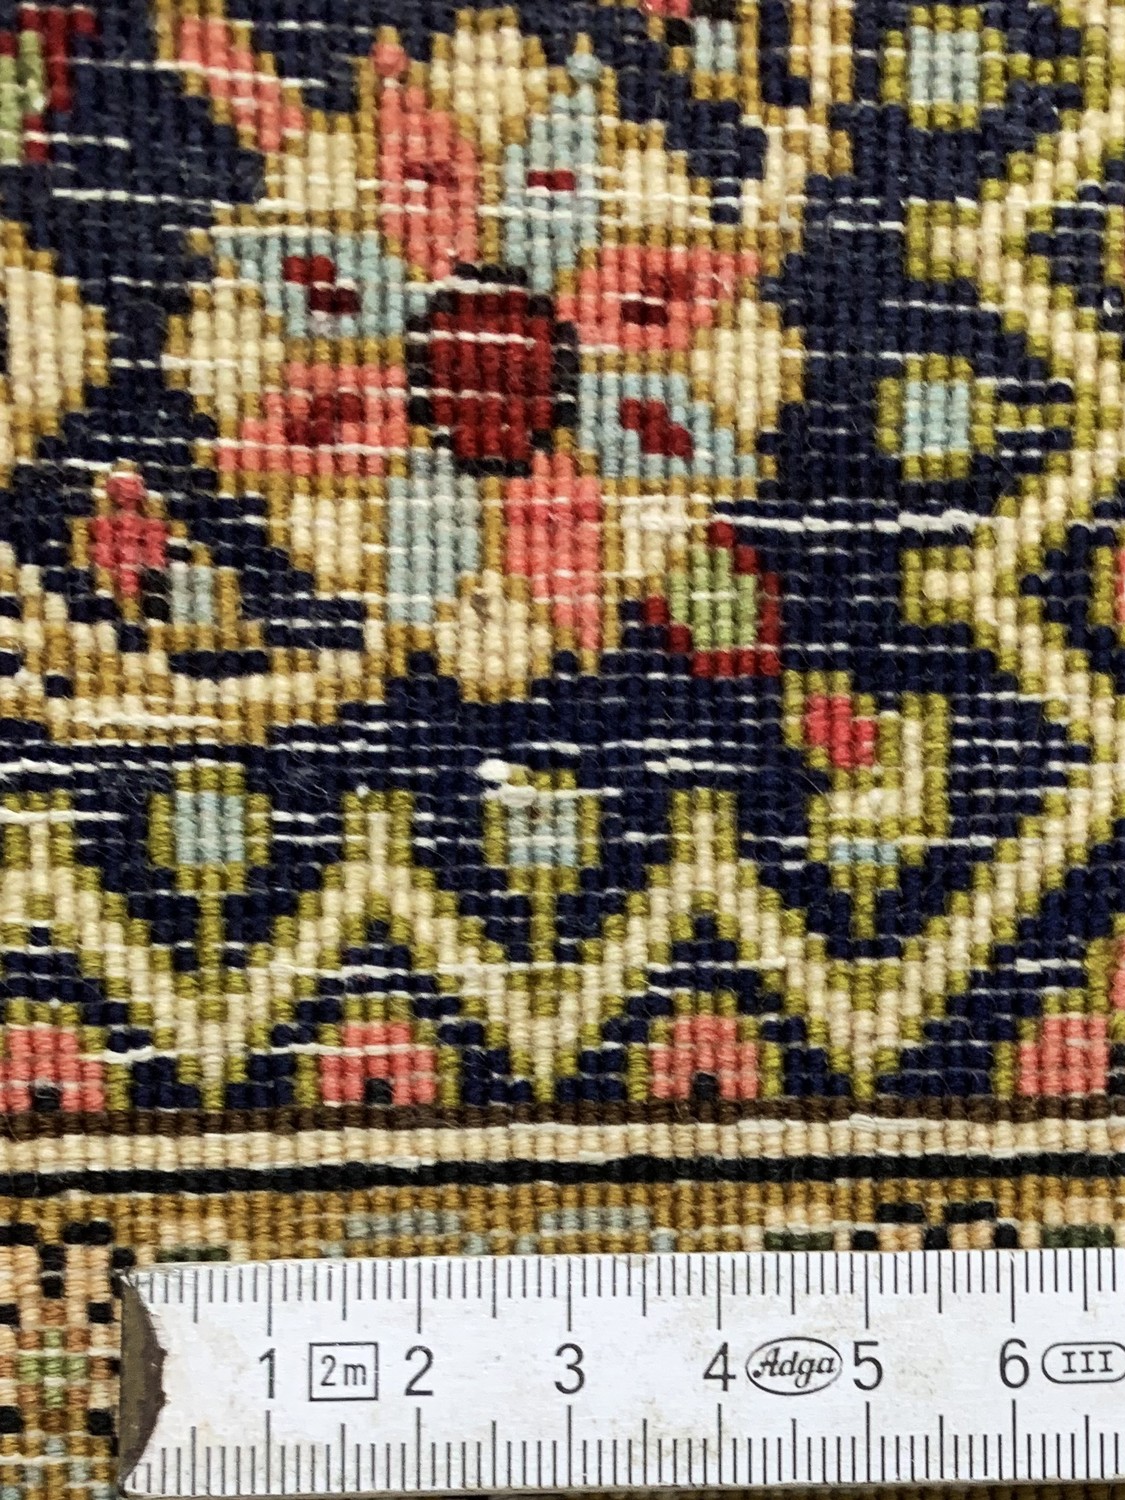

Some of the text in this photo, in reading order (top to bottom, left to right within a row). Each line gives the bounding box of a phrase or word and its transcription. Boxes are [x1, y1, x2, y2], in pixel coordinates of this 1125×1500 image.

[259, 1347, 276, 1399] 1
[404, 1345, 434, 1396] 2
[554, 1343, 586, 1395] 3
[702, 1342, 737, 1392] 4
[853, 1340, 884, 1391] 5
[999, 1338, 1030, 1389] 6
[752, 1346, 835, 1389] Adga
